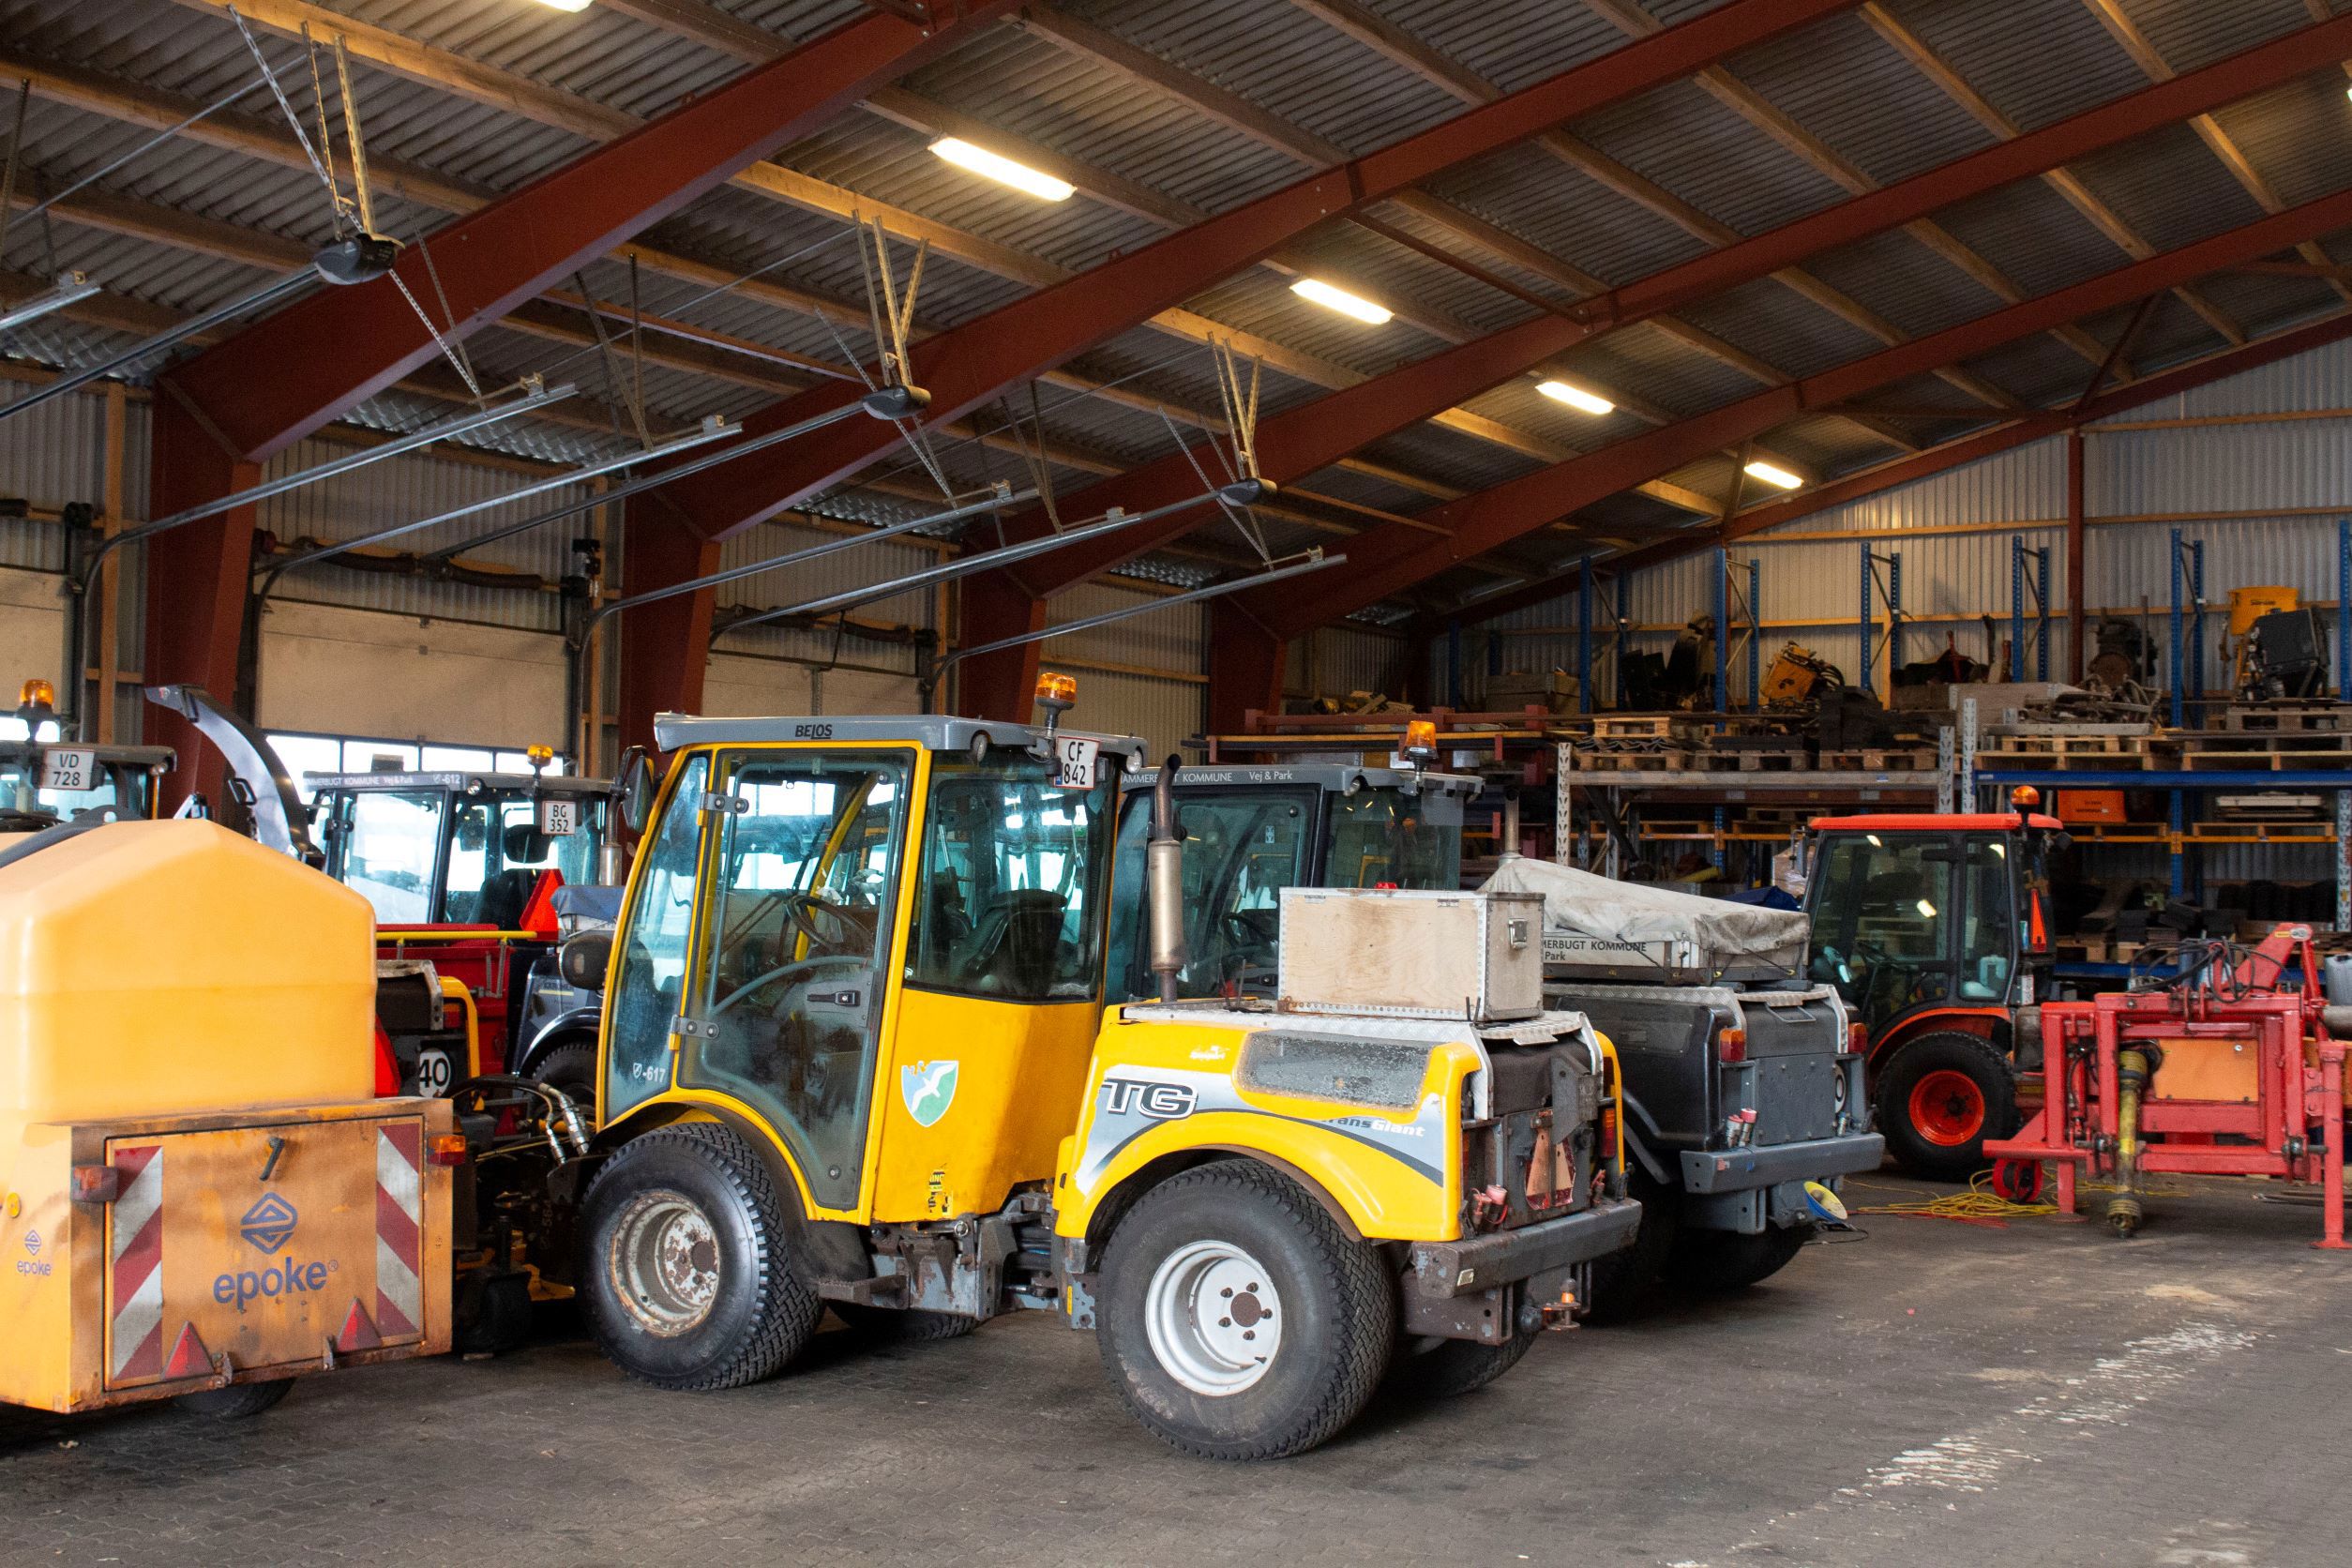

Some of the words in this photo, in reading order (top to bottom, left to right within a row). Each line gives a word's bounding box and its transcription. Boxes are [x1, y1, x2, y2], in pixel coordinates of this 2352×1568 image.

[795, 724, 833, 739] BELOS
[1068, 741, 1084, 761] CF
[59, 754, 80, 768] VD
[53, 772, 81, 786] 728
[1063, 763, 1086, 785] 842
[1183, 772, 1233, 783] KOMMUNE
[1249, 771, 1262, 782] Vej
[1265, 771, 1272, 780] &
[1274, 770, 1293, 781] Park
[553, 805, 566, 818] BG
[550, 819, 569, 833] 352
[1591, 941, 1647, 952] KOMMUNE
[1545, 951, 1566, 961] Park
[419, 1058, 449, 1087] 40
[1101, 1078, 1199, 1121] TG
[17, 1259, 52, 1276] epoke
[213, 1257, 327, 1310] epoke
